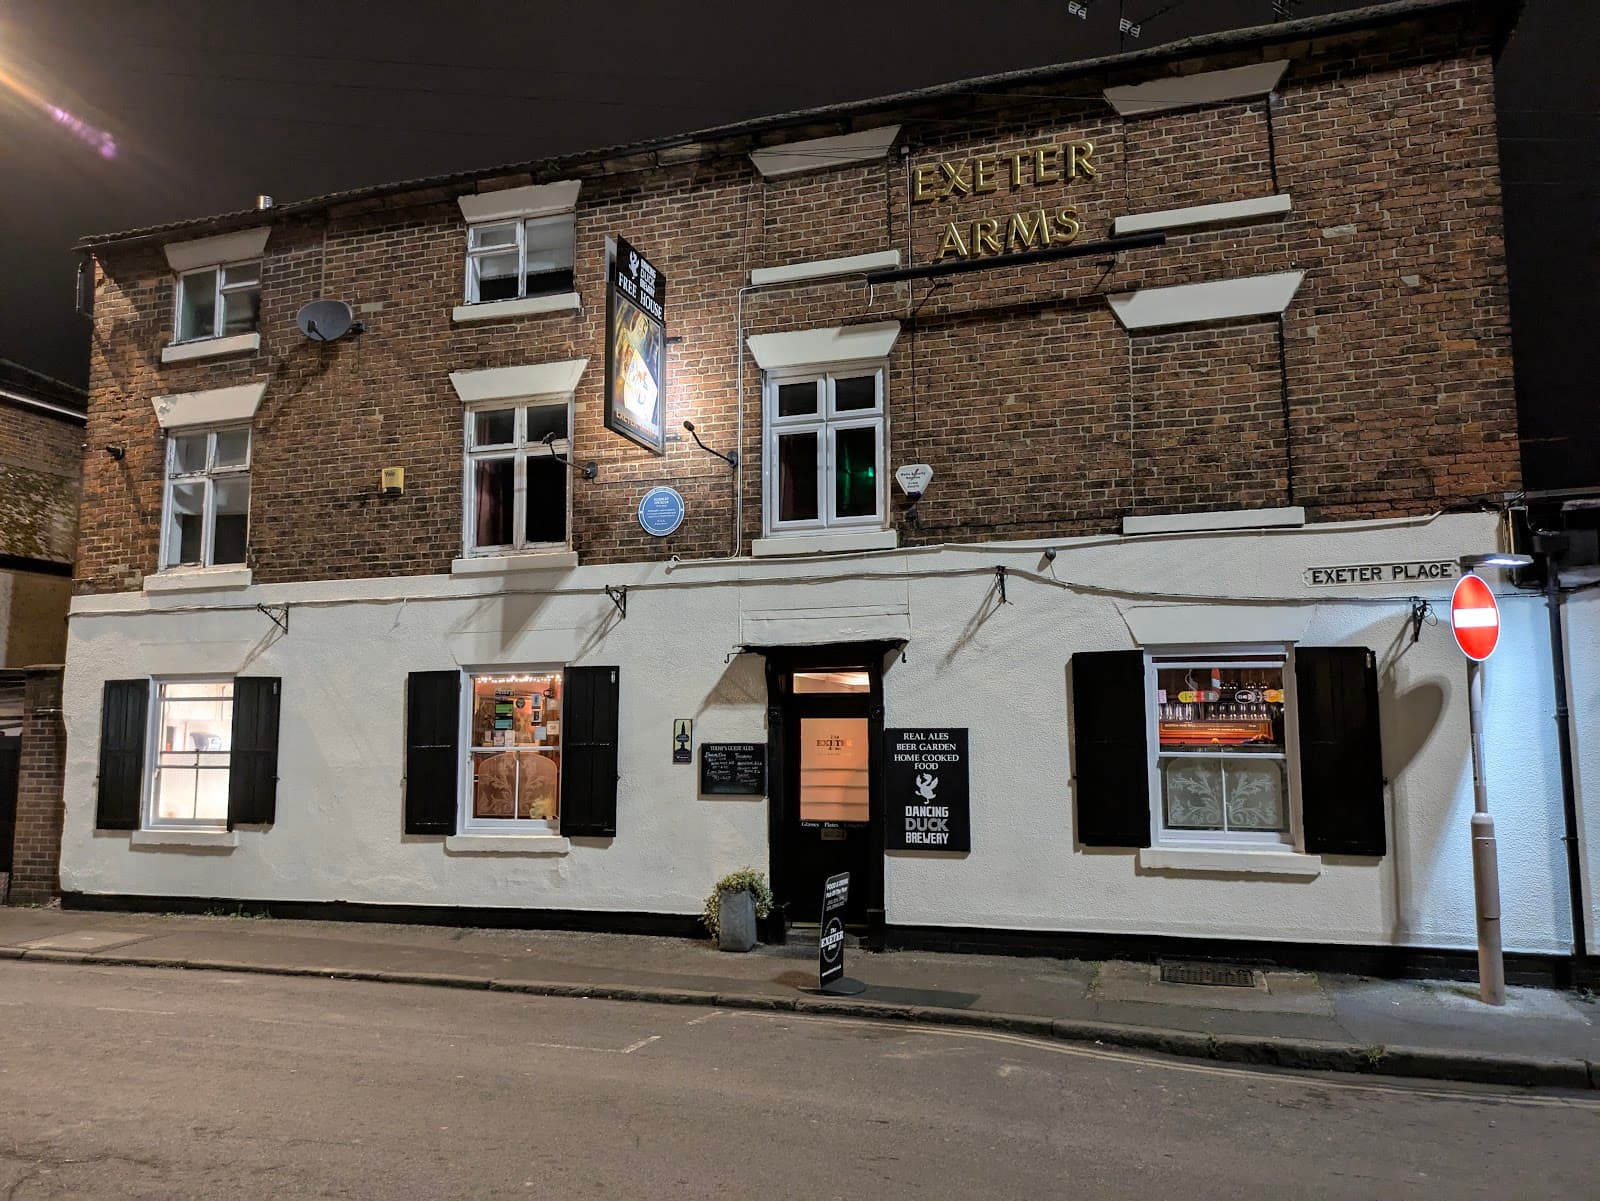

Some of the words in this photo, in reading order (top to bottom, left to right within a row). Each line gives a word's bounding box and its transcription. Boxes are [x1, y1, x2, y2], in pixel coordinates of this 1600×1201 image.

[914, 141, 1097, 201] EXETER
[936, 205, 1080, 259] ARMS
[618, 271, 637, 299] FREE
[640, 290, 663, 320] HOUSE
[1312, 567, 1382, 585] EXETER
[1392, 563, 1453, 581] PLACE
[903, 732, 926, 741] REAL
[928, 732, 949, 740] ALES
[896, 743, 917, 751] BEER
[919, 743, 956, 751] GARDEN
[894, 753, 920, 762] HOME
[921, 753, 960, 762] COOKED
[914, 762, 939, 770] FOOD
[904, 805, 949, 817] DANCING
[904, 817, 950, 832] DUCK
[905, 832, 949, 845] BREWERY
[820, 930, 844, 949] EXETER
